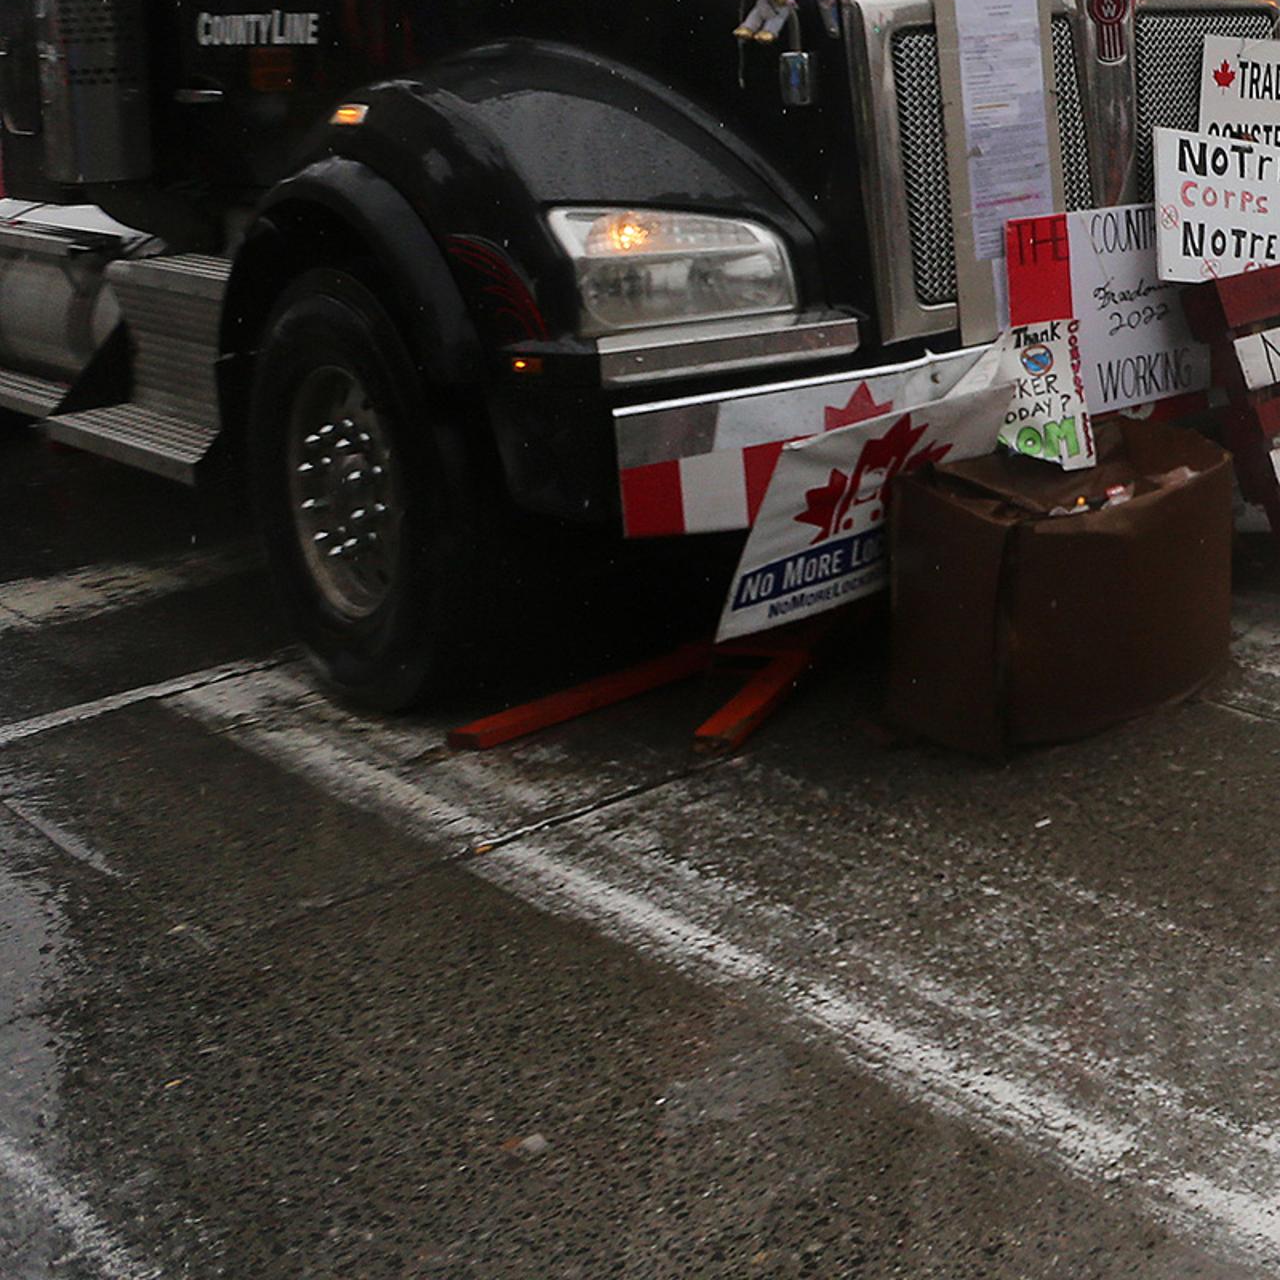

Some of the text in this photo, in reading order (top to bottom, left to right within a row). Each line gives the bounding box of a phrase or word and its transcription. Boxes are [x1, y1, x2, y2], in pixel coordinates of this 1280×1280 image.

[1014, 217, 1070, 266] THE
[1108, 303, 1169, 337] 2022
[1013, 374, 1060, 400] KER
[1097, 347, 1193, 404] WORKING
[1008, 416, 1081, 459] OM
